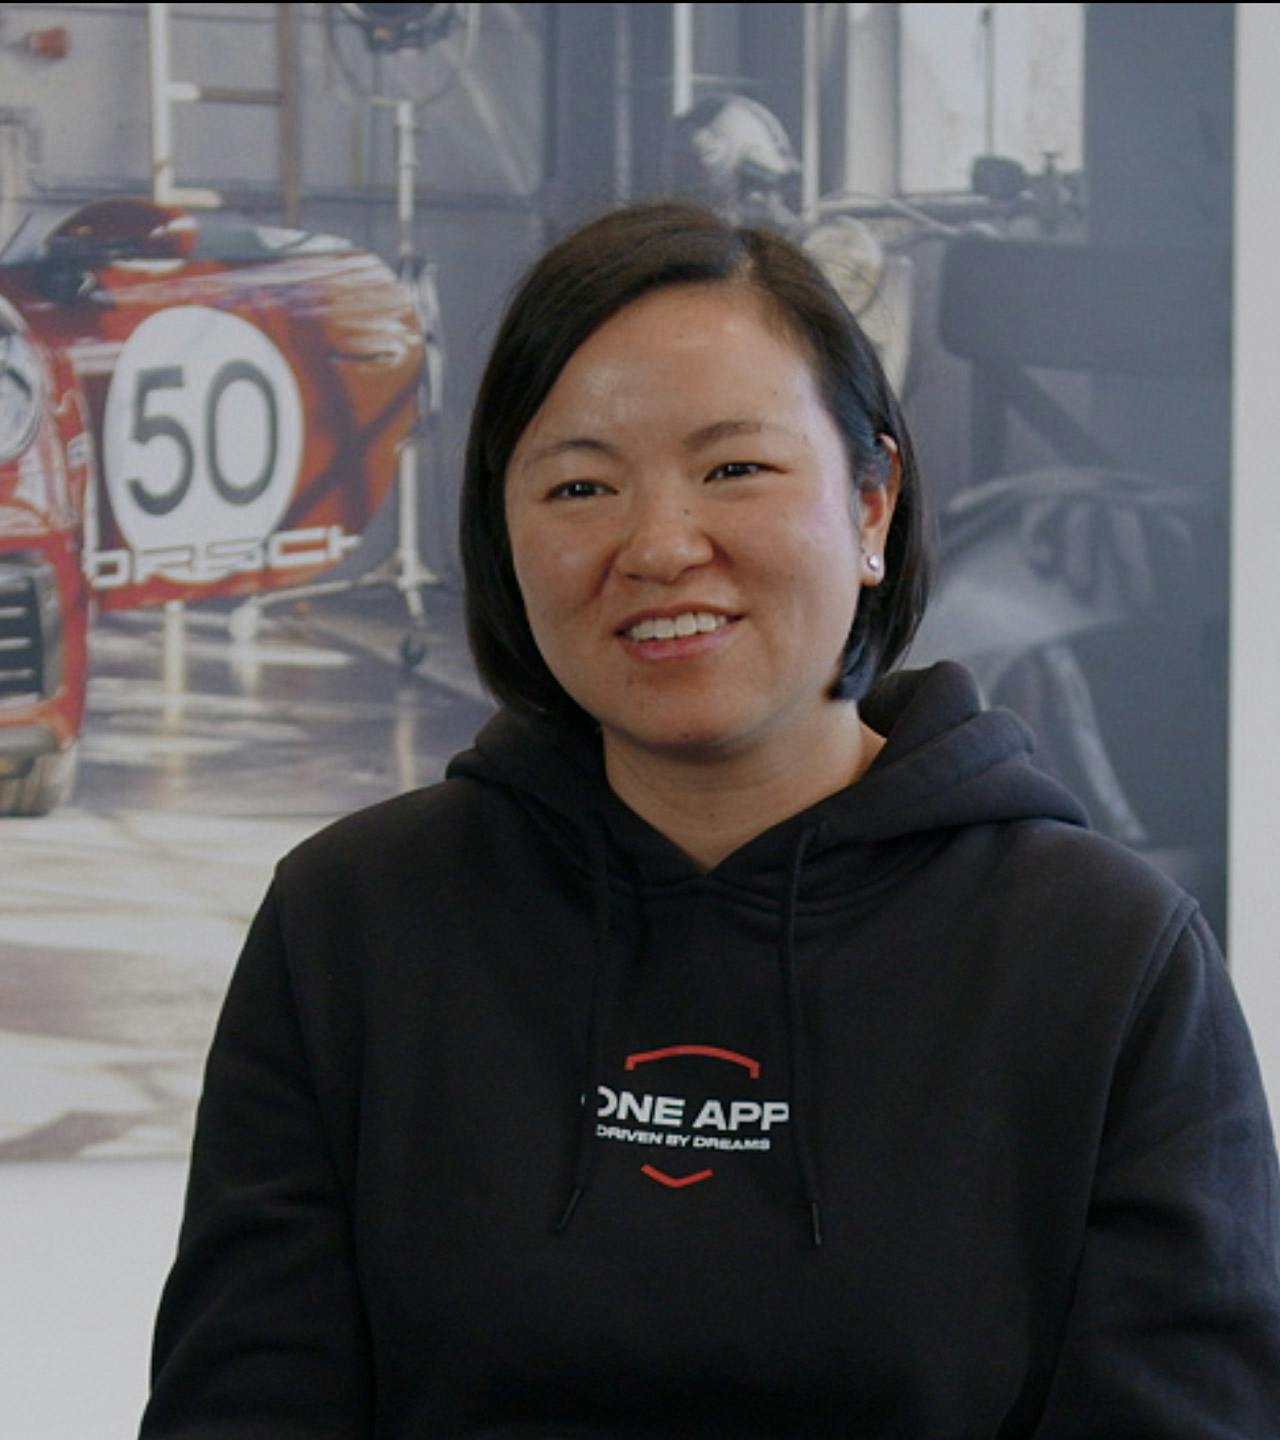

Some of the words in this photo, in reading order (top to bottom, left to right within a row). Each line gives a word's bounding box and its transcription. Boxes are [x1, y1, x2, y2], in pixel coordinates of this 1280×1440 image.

[126, 358, 279, 517] 50
[692, 1099, 790, 1131] APP
[595, 1124, 663, 1145] DRIVEN
[665, 1132, 691, 1147] BY
[692, 1135, 770, 1151] DREAMS
